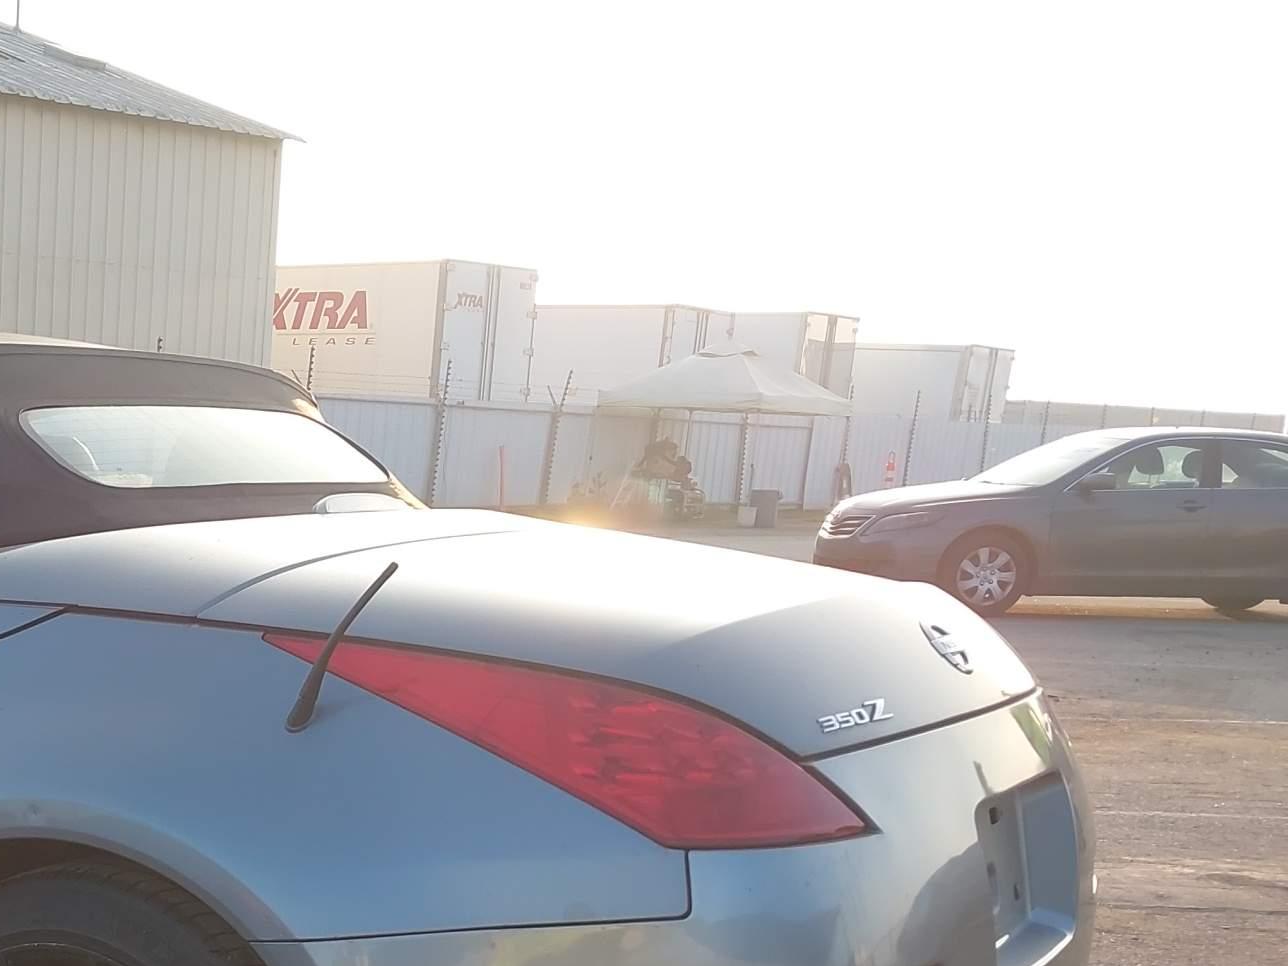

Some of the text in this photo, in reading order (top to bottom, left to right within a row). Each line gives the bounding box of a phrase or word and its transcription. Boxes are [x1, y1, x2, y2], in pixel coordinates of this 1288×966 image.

[272, 288, 368, 330] XTRA
[455, 292, 483, 309] XTRA
[292, 337, 376, 346] LEASE
[816, 698, 894, 733] 350Z
